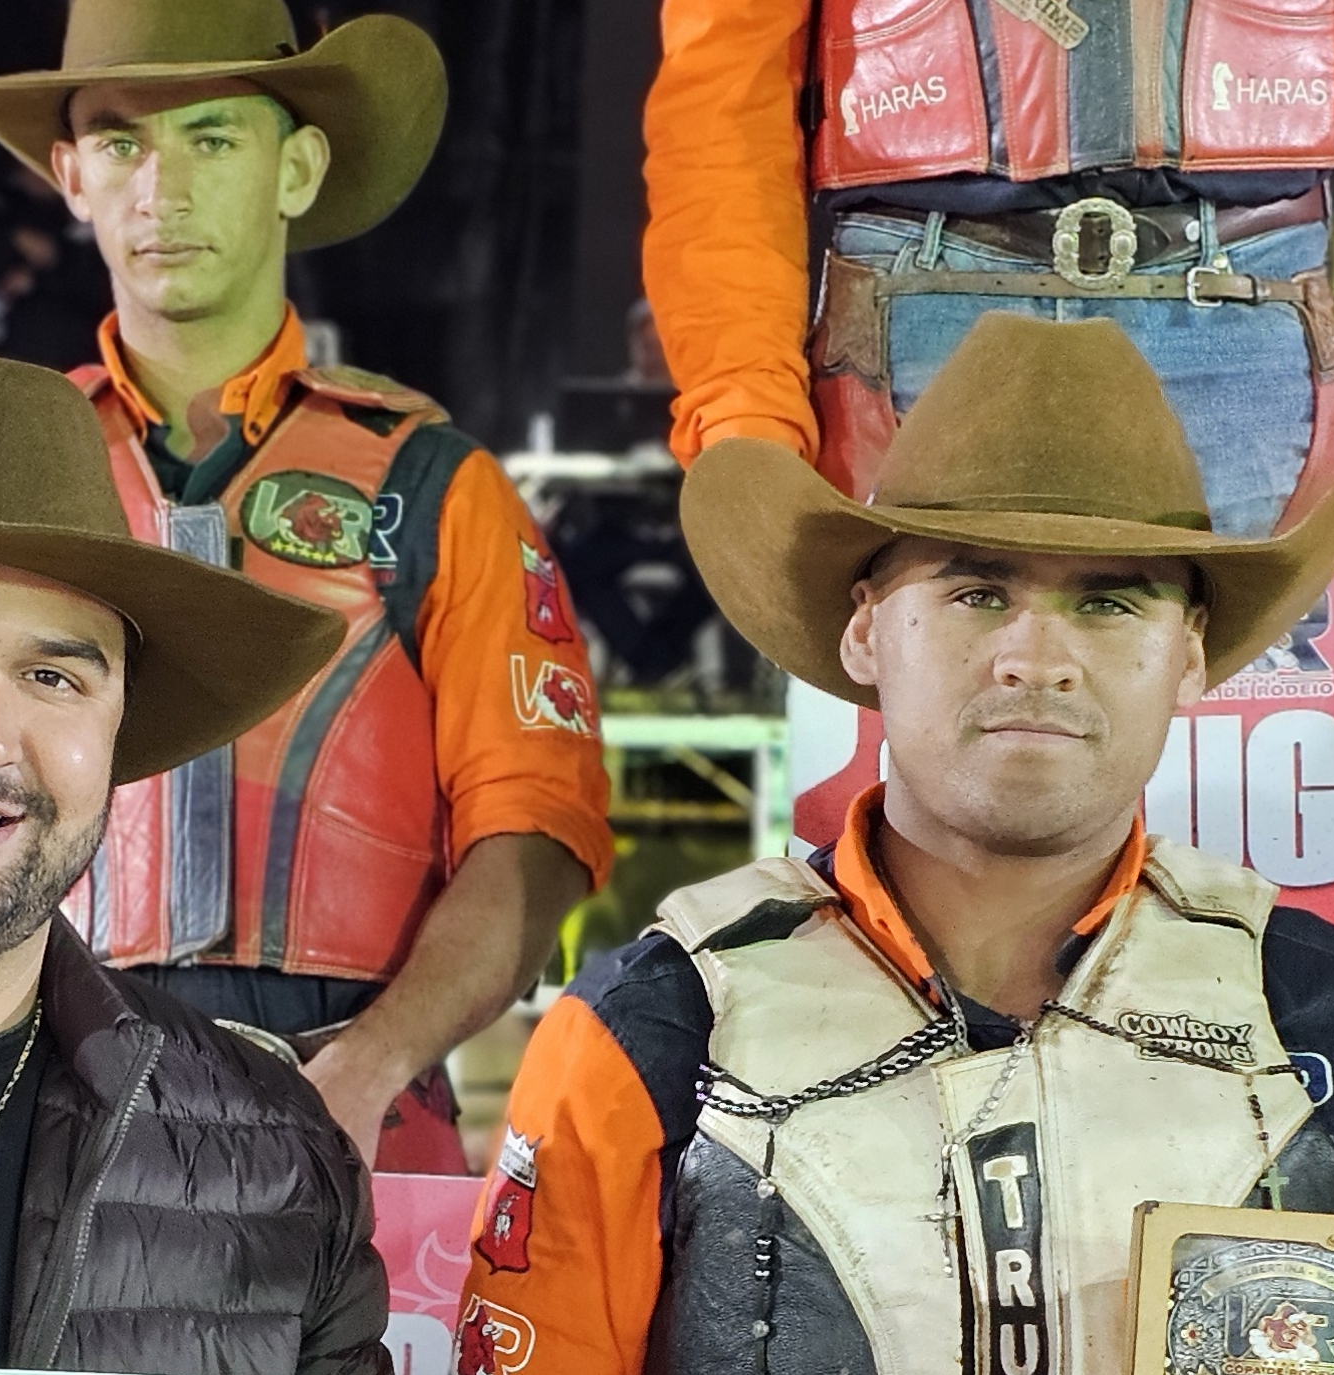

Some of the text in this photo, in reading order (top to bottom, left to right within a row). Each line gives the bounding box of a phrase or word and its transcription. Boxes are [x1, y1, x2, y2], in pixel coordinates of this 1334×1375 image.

[859, 75, 948, 124] HARAS
[1236, 77, 1328, 106] HARAS
[1256, 681, 1334, 698] RODEIO
[1119, 1014, 1253, 1044] COWBOY
[1224, 1363, 1262, 1375] COPA
[1266, 1366, 1284, 1375] DE
